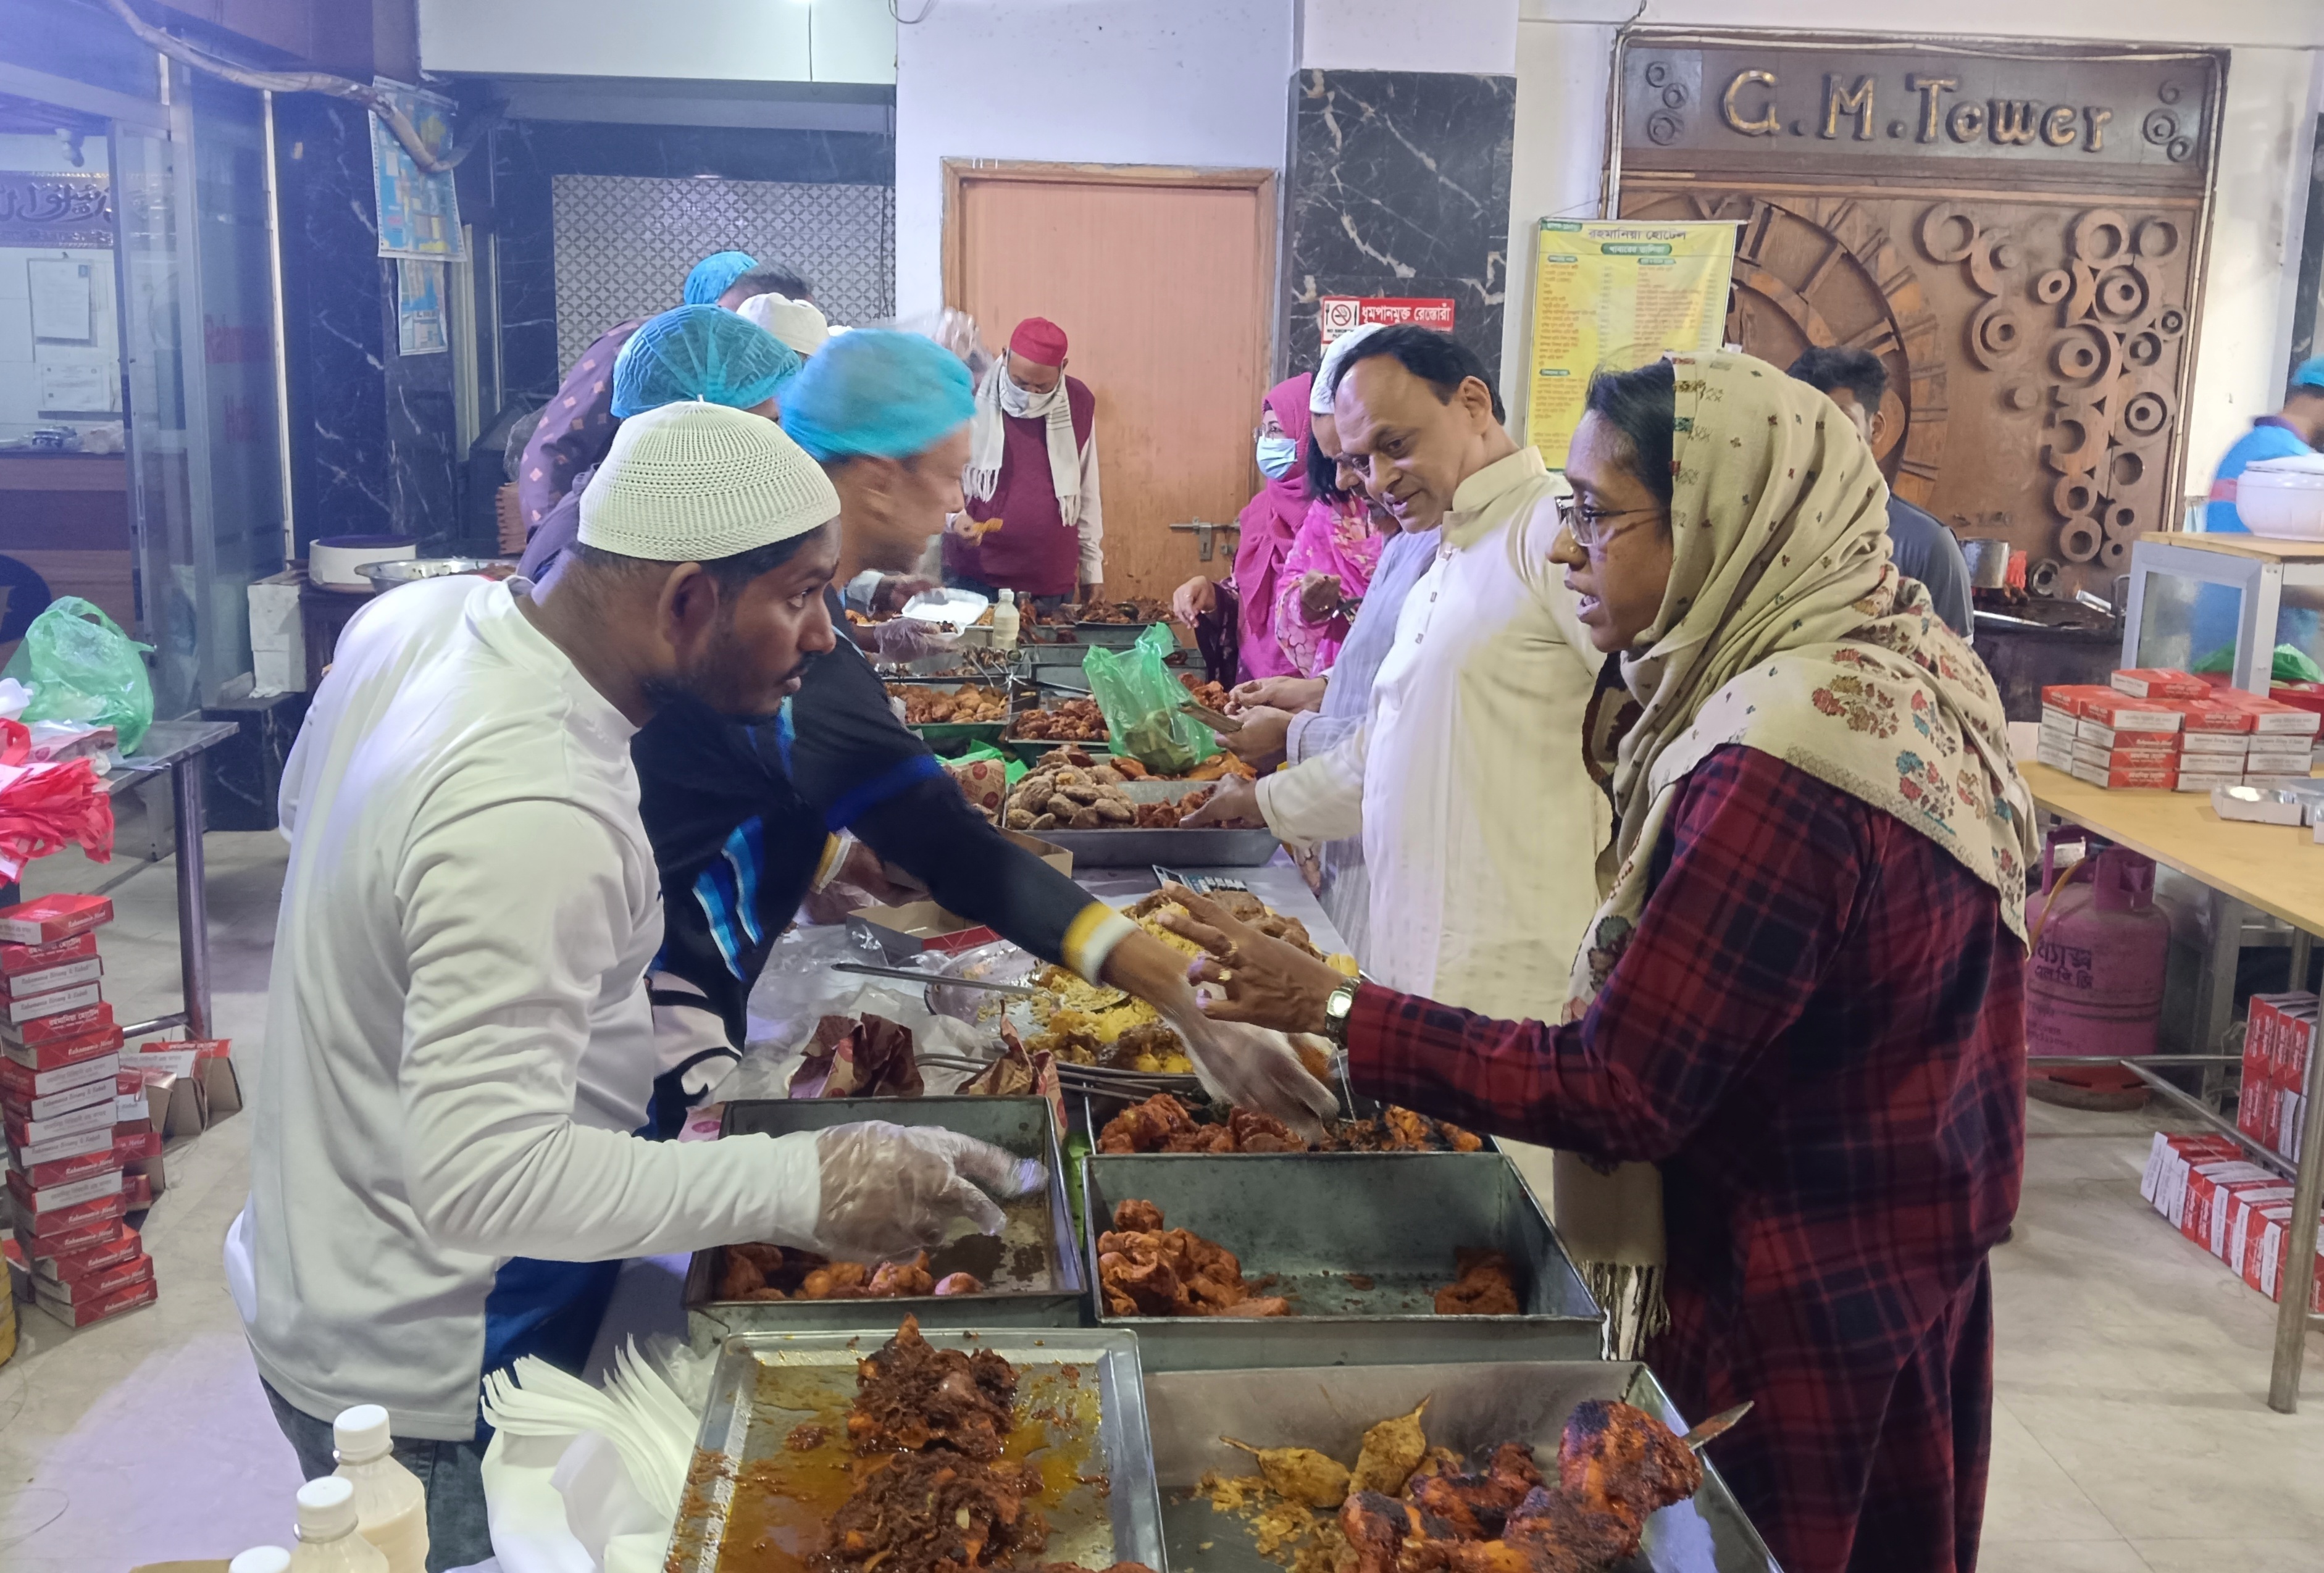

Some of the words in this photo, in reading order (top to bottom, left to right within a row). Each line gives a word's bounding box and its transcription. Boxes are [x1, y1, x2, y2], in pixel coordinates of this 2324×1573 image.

[1588, 227, 1641, 240] রহমানিয়া
[1646, 227, 1686, 240] হোটেল
[1361, 305, 1412, 323] ধূমপানমুক্ত
